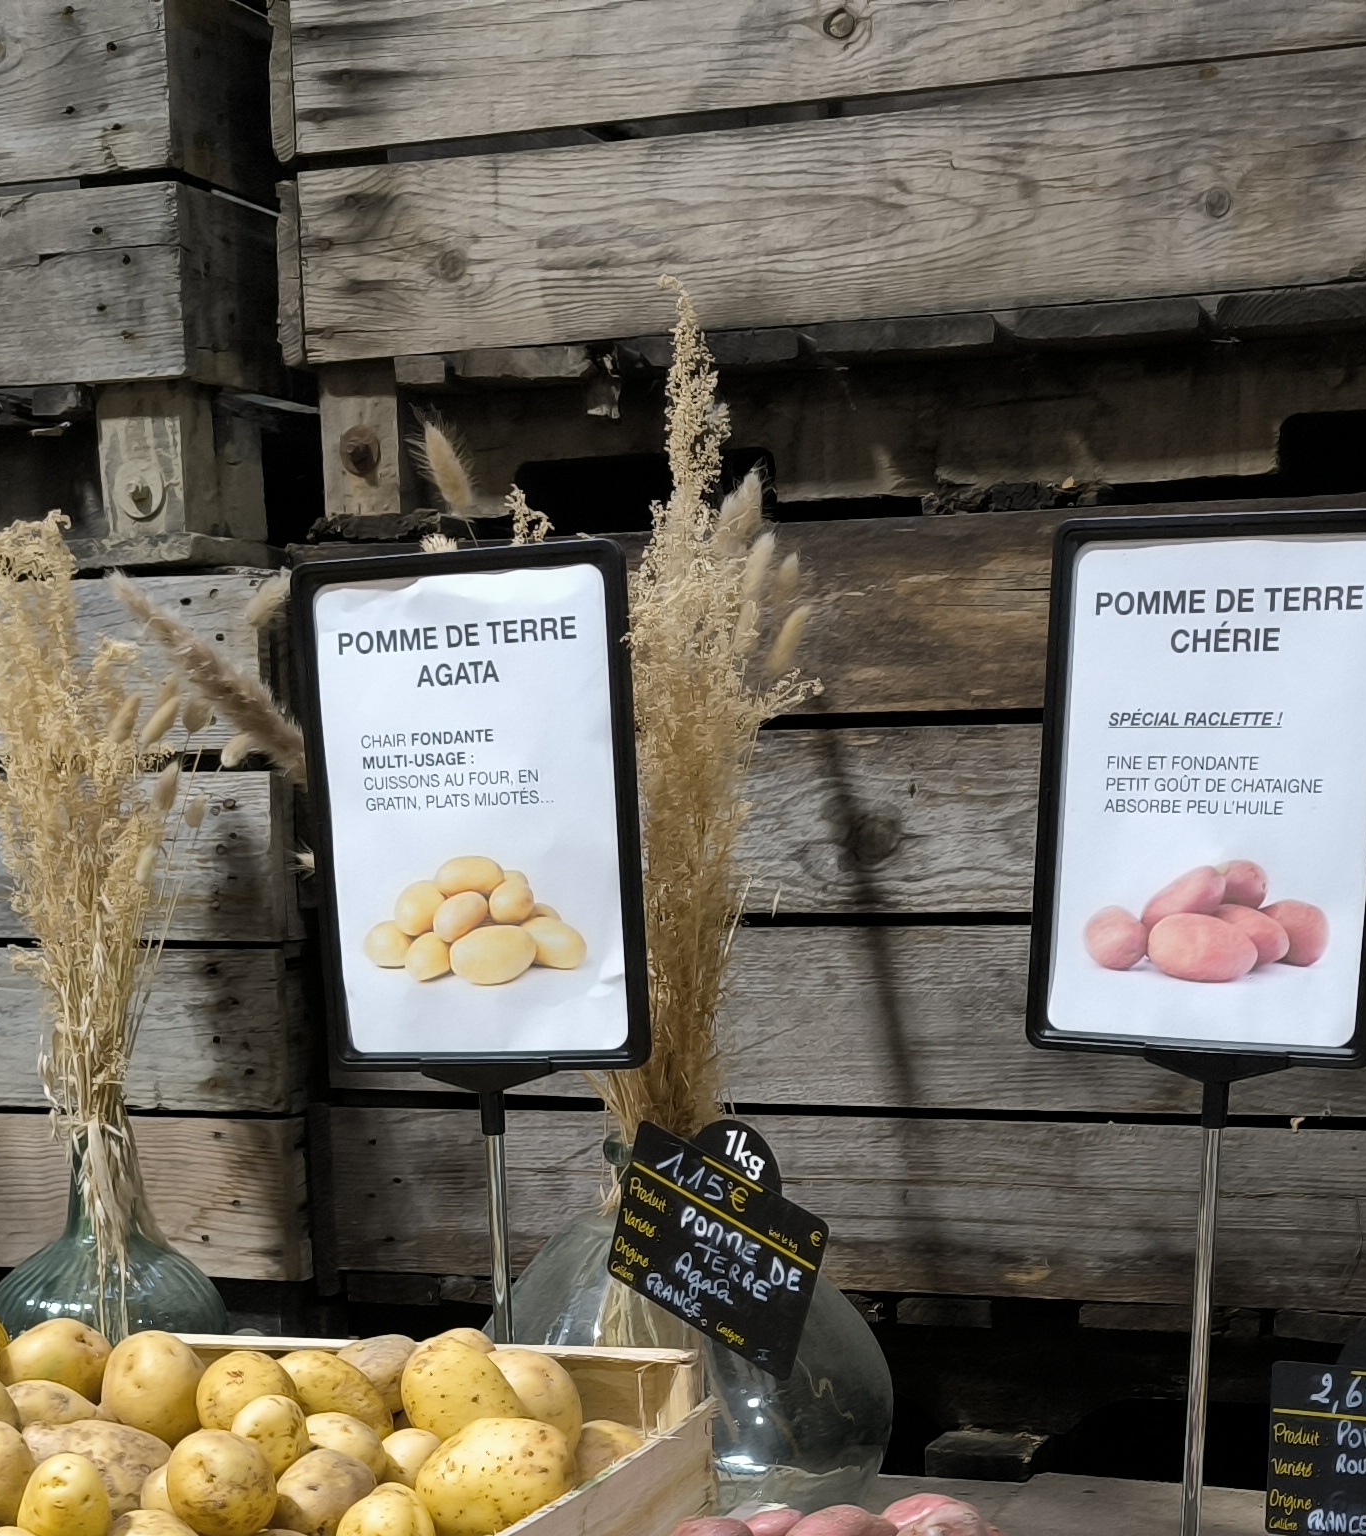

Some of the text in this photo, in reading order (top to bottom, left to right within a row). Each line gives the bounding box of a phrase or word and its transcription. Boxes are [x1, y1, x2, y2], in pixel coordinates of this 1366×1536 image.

[1096, 586, 1364, 615] POMME DE TERRE
[338, 616, 577, 655] POMME DE TERRE
[1171, 621, 1280, 653] CHÉRIE
[418, 660, 499, 687] AGATA
[1108, 708, 1179, 727] SPÉCIAL
[1184, 711, 1273, 727] RACLETTE
[361, 729, 493, 748] CHAIR FONDANTE
[363, 752, 466, 769] MULTI-USAGE
[1108, 756, 1259, 770] FINE ET FONDANTE
[364, 769, 538, 790] CUISSONS AU FOUR, EN
[1106, 775, 1323, 793] PETIT GOÛT DE CHATAIGNE
[365, 796, 421, 812] GRATIN,
[426, 794, 470, 808] PLATS
[1104, 799, 1283, 815] ABSORBE PEU L'HUILE
[726, 1130, 765, 1181] 1kg
[630, 1177, 667, 1213] Produit
[810, 1231, 823, 1247] €
[615, 1236, 649, 1267] Origine
[695, 1242, 771, 1302] TERRE
[770, 1256, 802, 1292] DE
[1274, 1423, 1319, 1446] Produit
[1271, 1458, 1313, 1477] Variété
[1269, 1488, 1312, 1515] Origine
